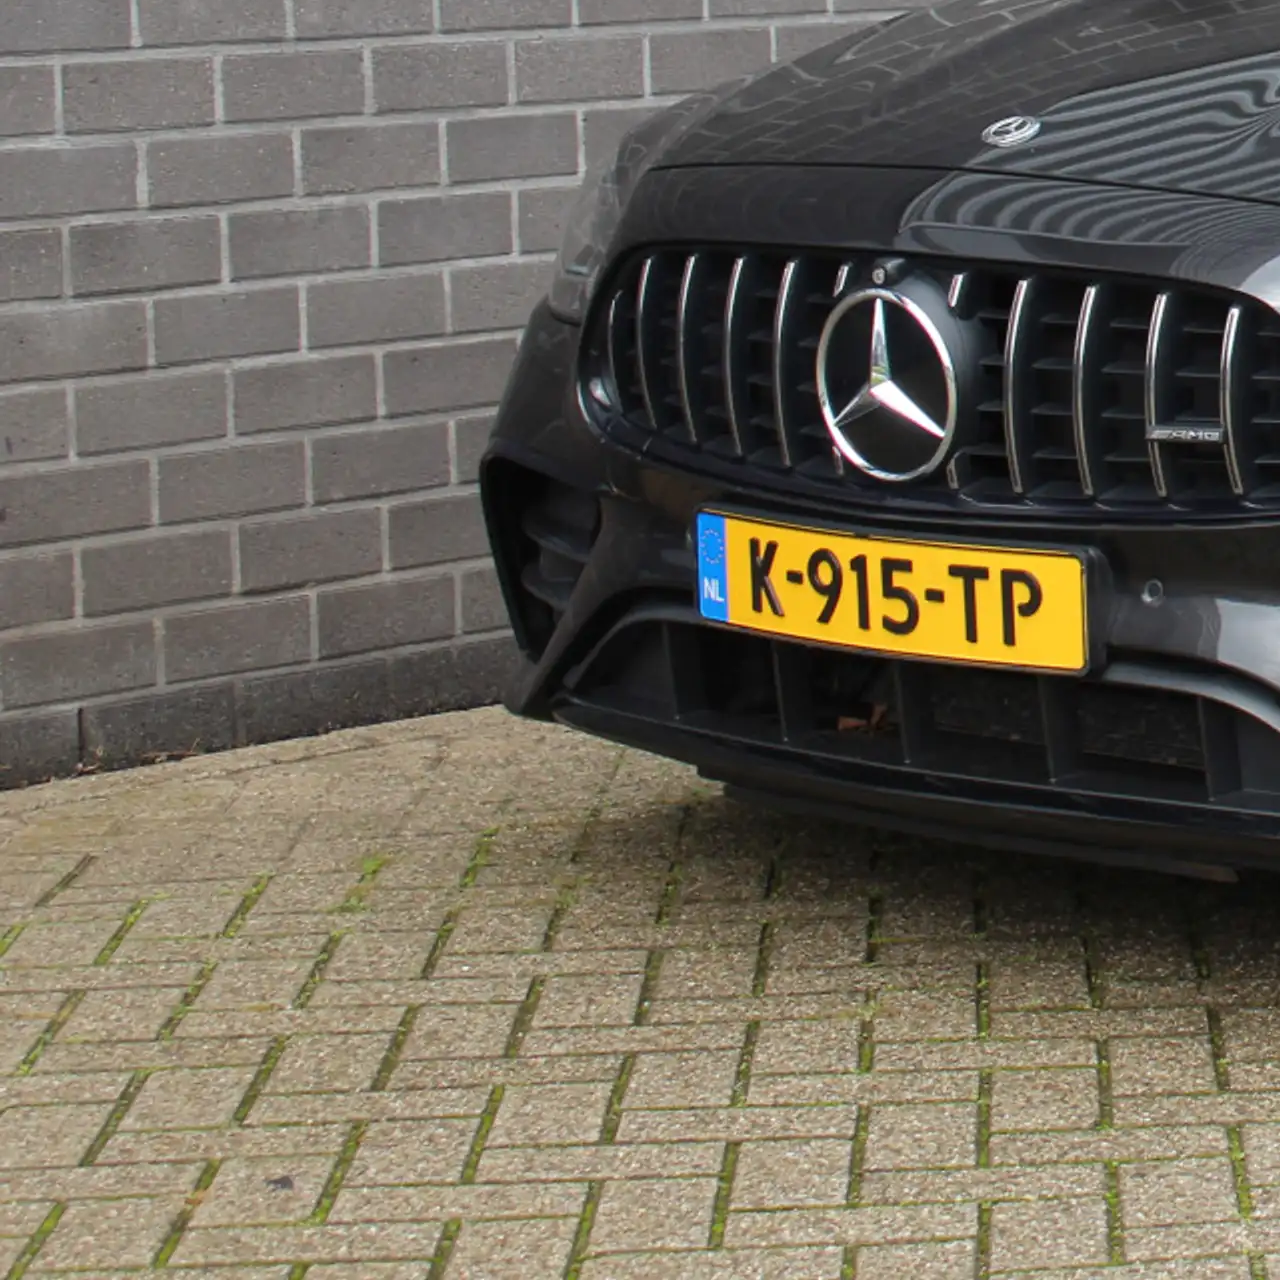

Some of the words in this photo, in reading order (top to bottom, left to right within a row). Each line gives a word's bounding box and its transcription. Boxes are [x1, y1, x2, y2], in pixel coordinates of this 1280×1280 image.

[1166, 429, 1220, 441] AMG
[703, 577, 725, 603] NL
[748, 536, 1043, 647] K-915-TP
